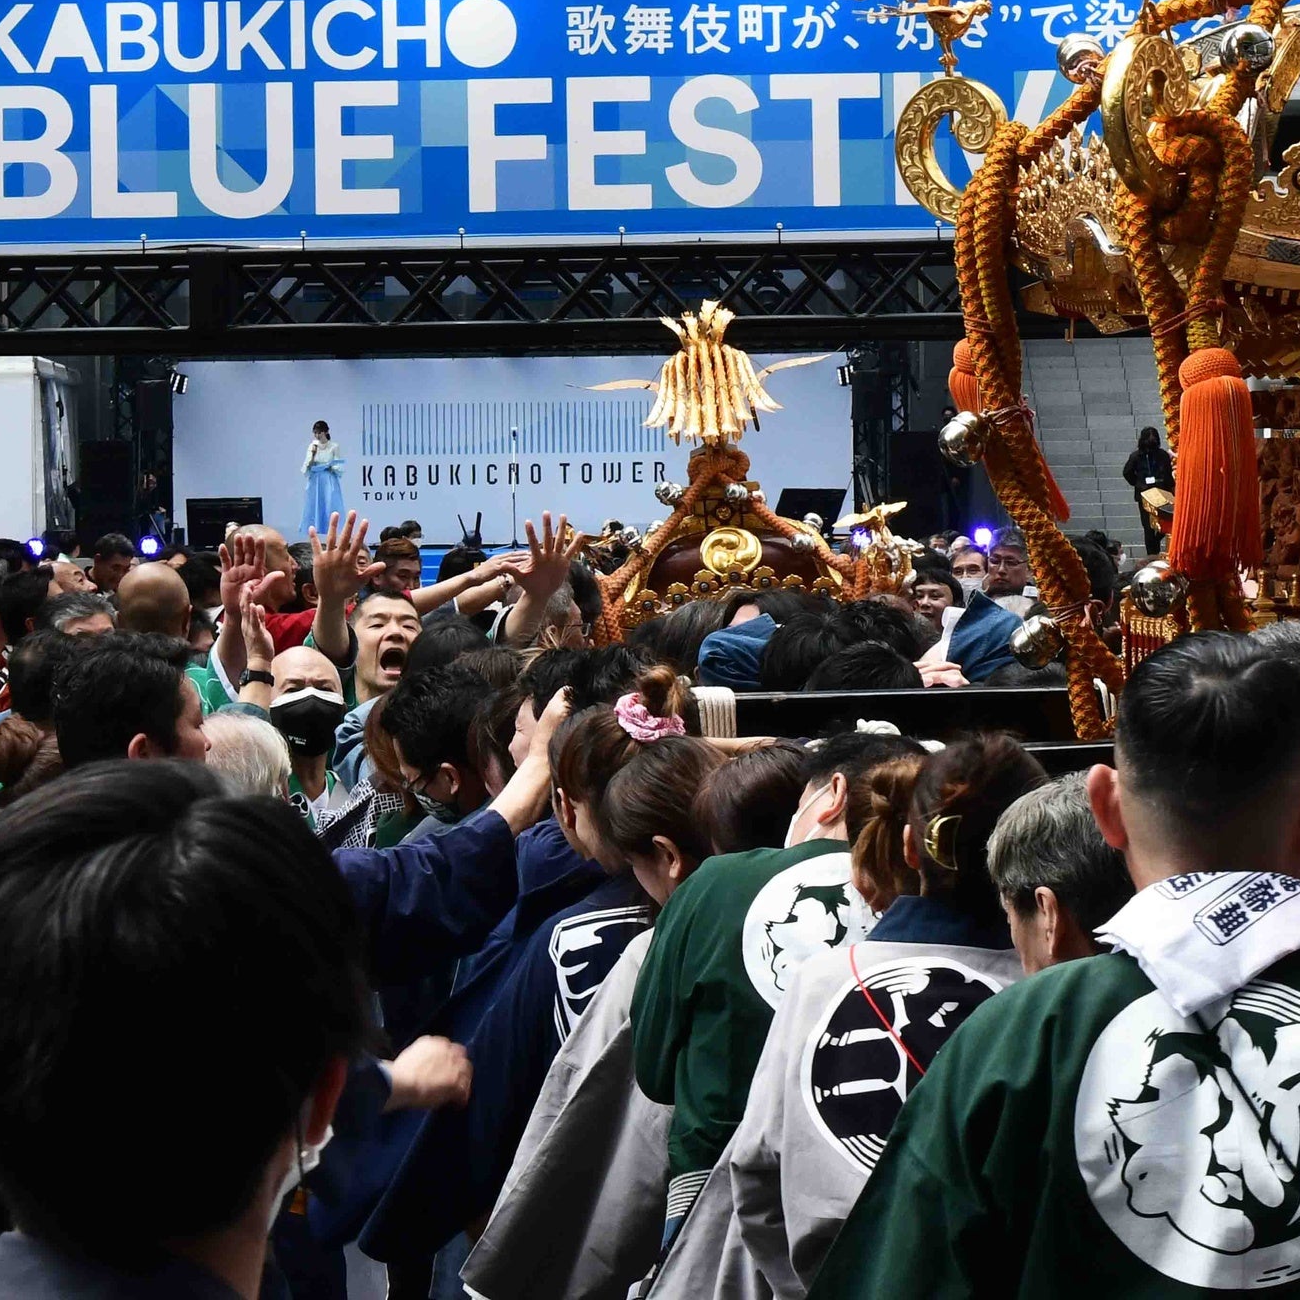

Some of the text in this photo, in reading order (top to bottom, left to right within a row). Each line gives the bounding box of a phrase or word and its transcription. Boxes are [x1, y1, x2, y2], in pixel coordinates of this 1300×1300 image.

[362, 461, 666, 487] KABUKICHO TOWER
[363, 491, 418, 501] TOKYU
